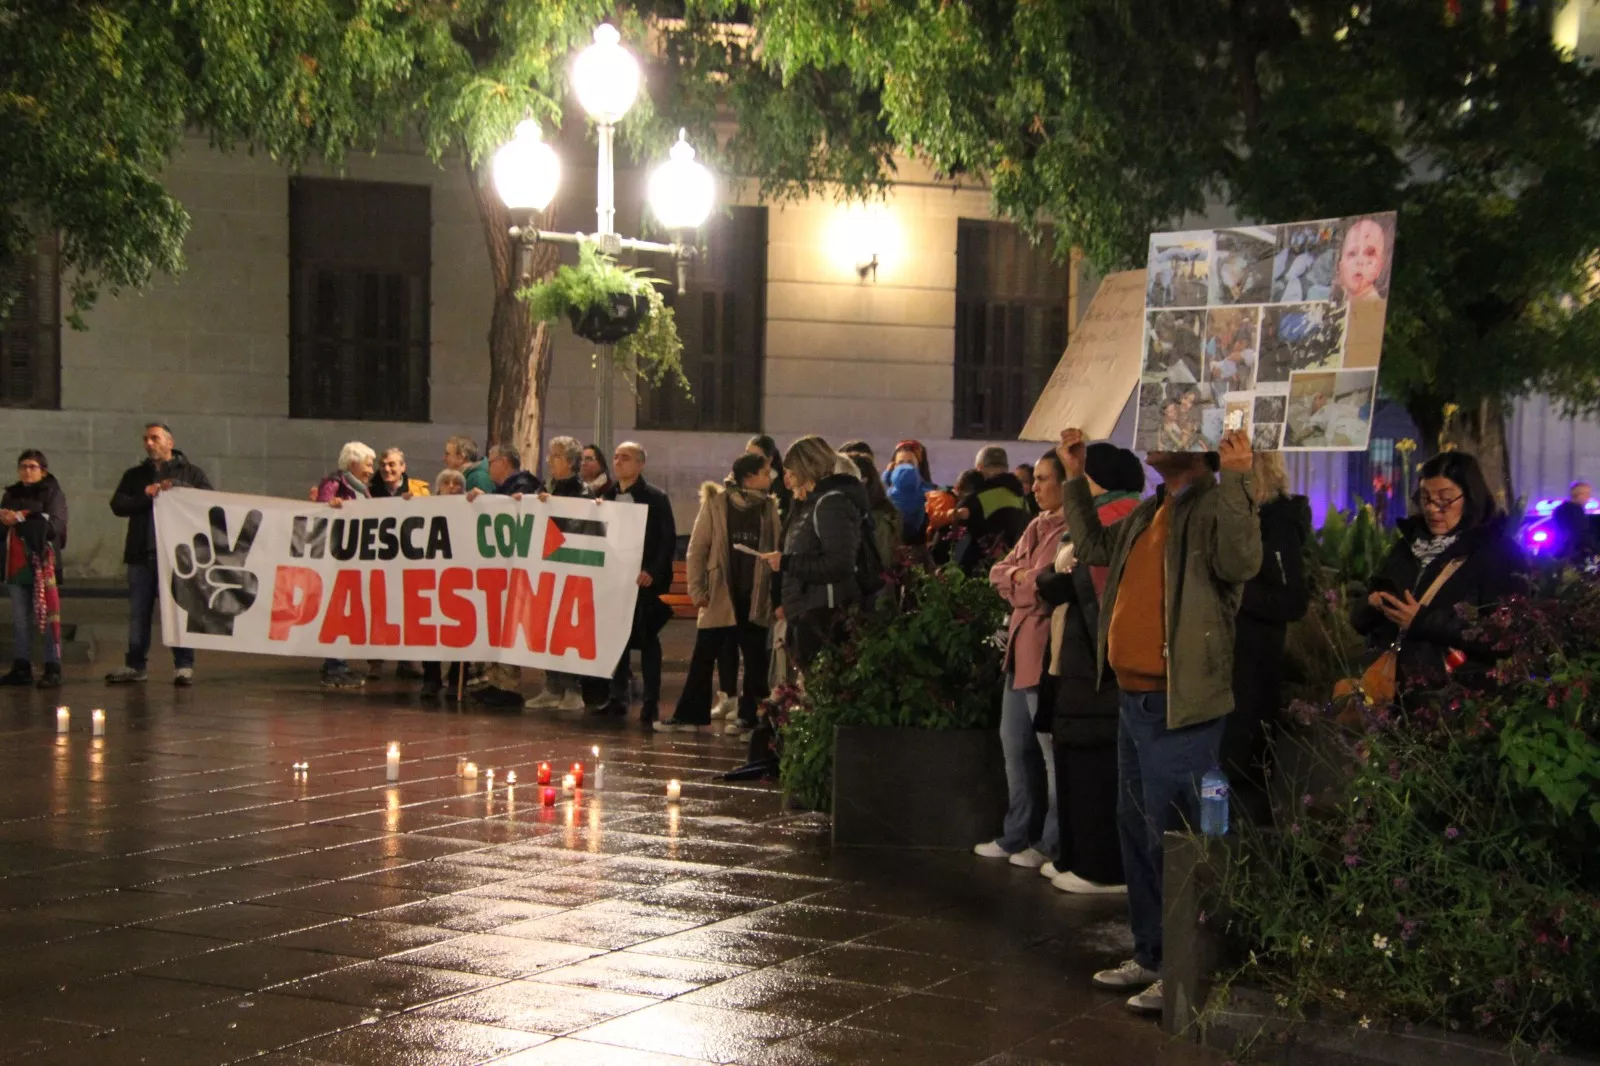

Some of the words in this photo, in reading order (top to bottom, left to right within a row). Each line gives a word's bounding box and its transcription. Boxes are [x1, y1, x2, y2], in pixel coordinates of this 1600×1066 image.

[290, 514, 453, 562] HUESCA
[476, 512, 535, 560] CON
[268, 564, 598, 661] PALESTNA
